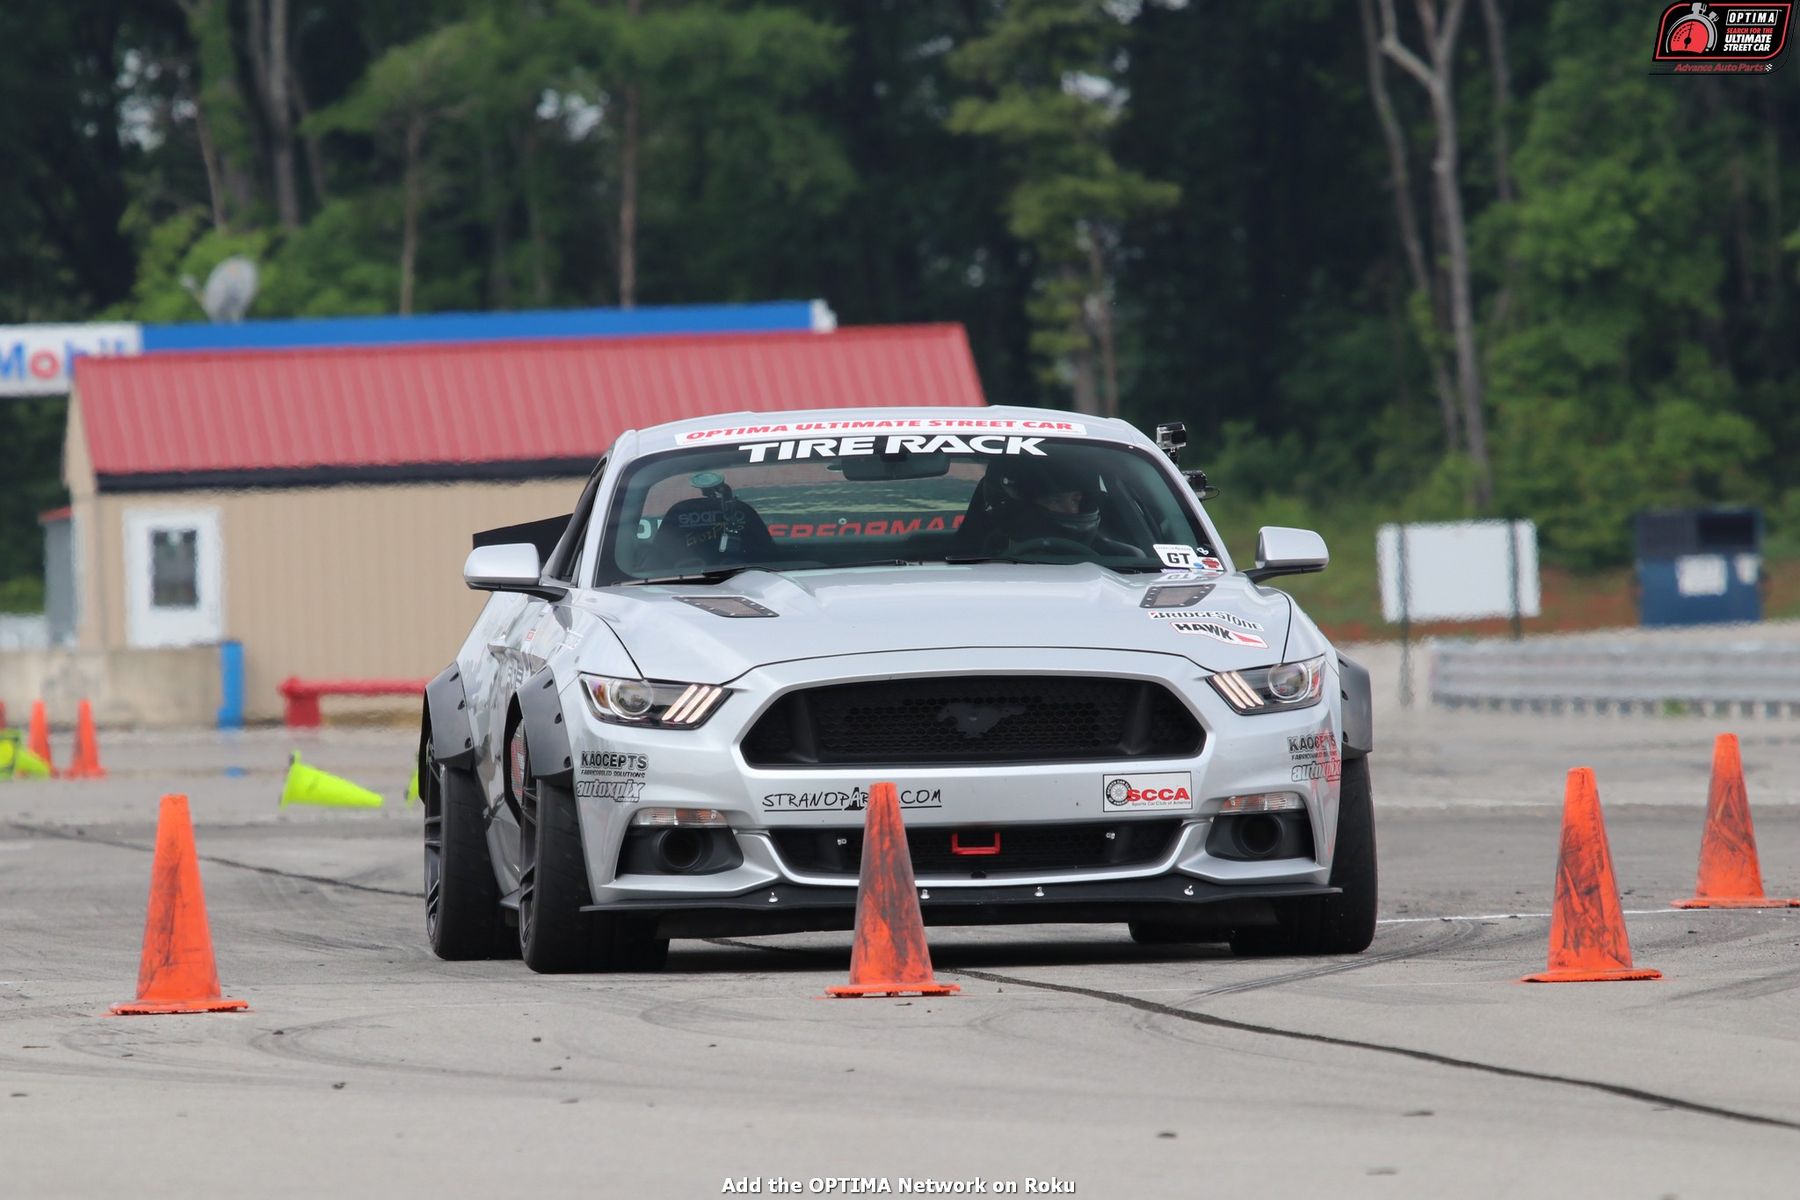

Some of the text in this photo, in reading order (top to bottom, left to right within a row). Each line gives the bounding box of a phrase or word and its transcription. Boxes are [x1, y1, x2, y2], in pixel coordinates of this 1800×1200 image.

[686, 419, 1073, 441] OPTIMA ULTIMATE STREET CAR
[739, 435, 1048, 463] TIRE RACK
[1166, 552, 1191, 565] GT
[1174, 623, 1234, 641] HAWK
[580, 752, 648, 770] KAOCEPTS
[1126, 787, 1190, 802] SCCA
